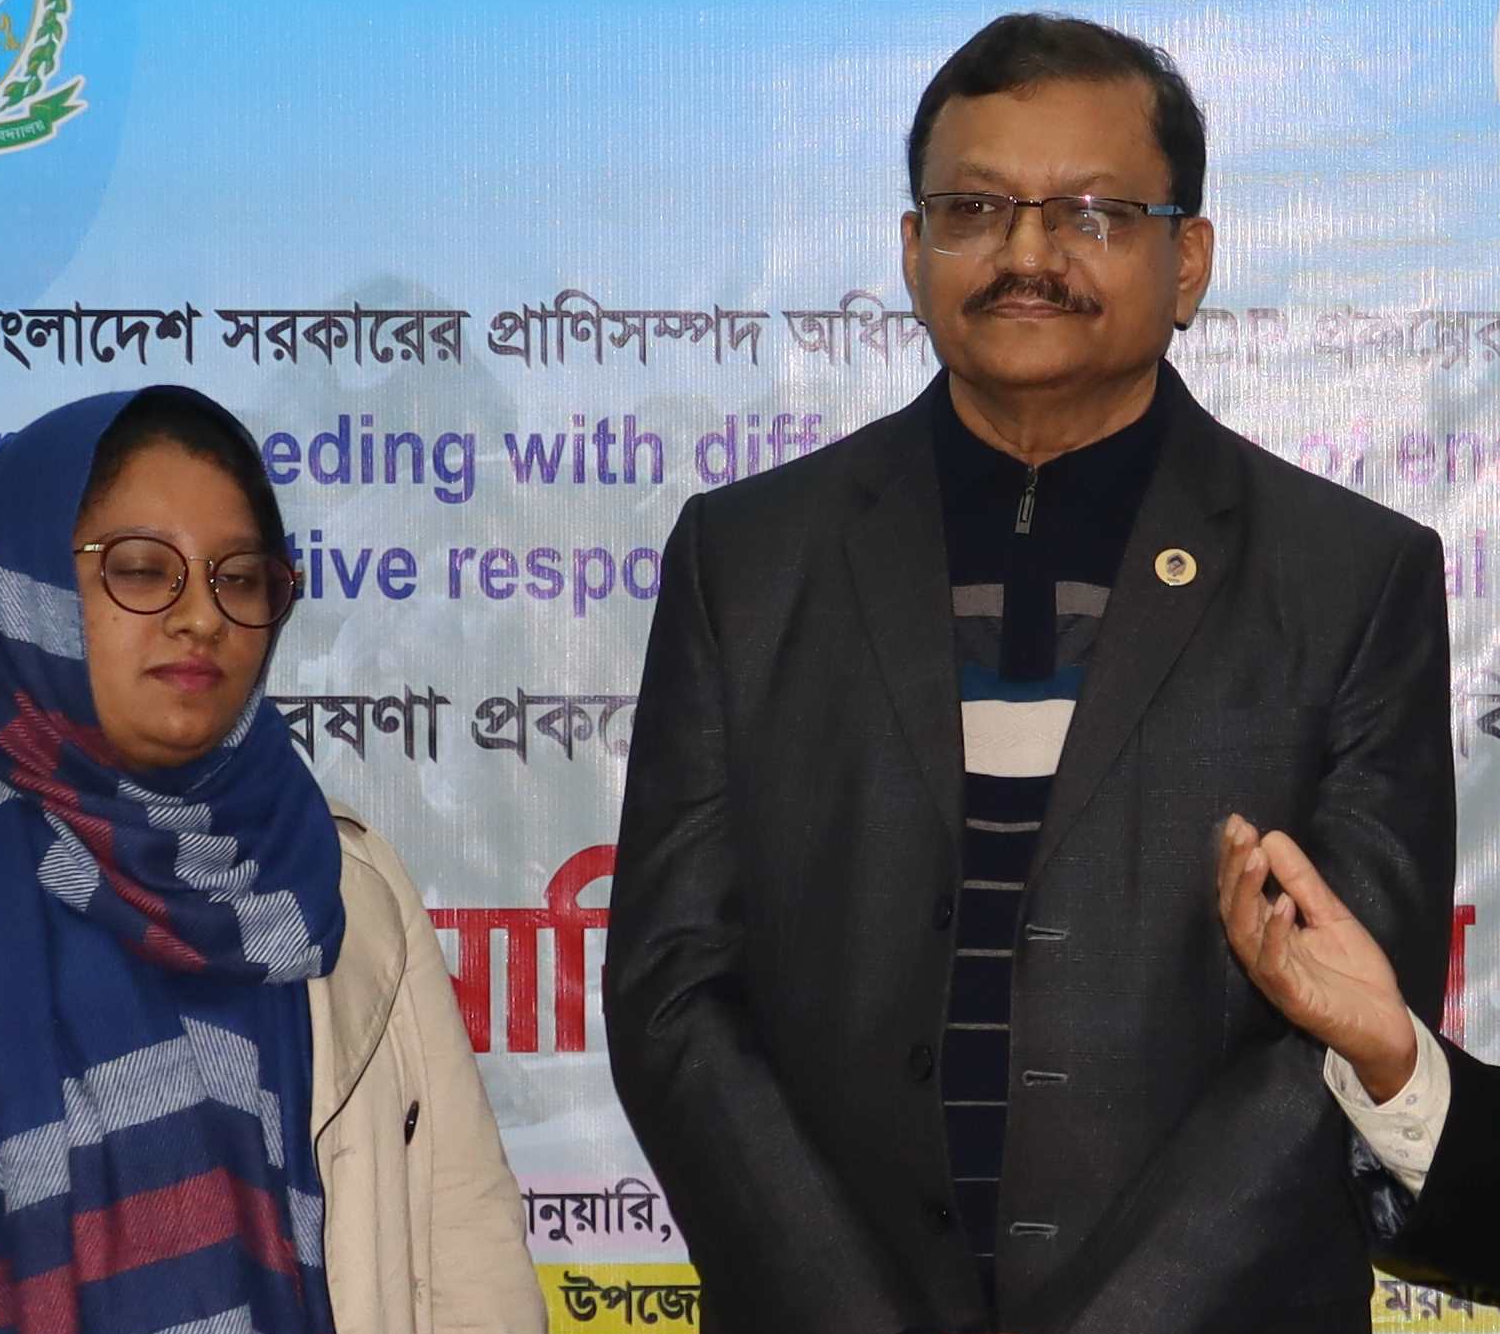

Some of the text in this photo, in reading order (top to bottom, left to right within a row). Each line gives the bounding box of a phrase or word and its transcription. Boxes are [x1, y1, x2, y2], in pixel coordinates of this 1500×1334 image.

[215, 301, 472, 366] সরকারের
[782, 289, 928, 367] অধিদ
[262, 414, 475, 503] eding
[504, 414, 665, 485] with
[448, 541, 660, 617] respo
